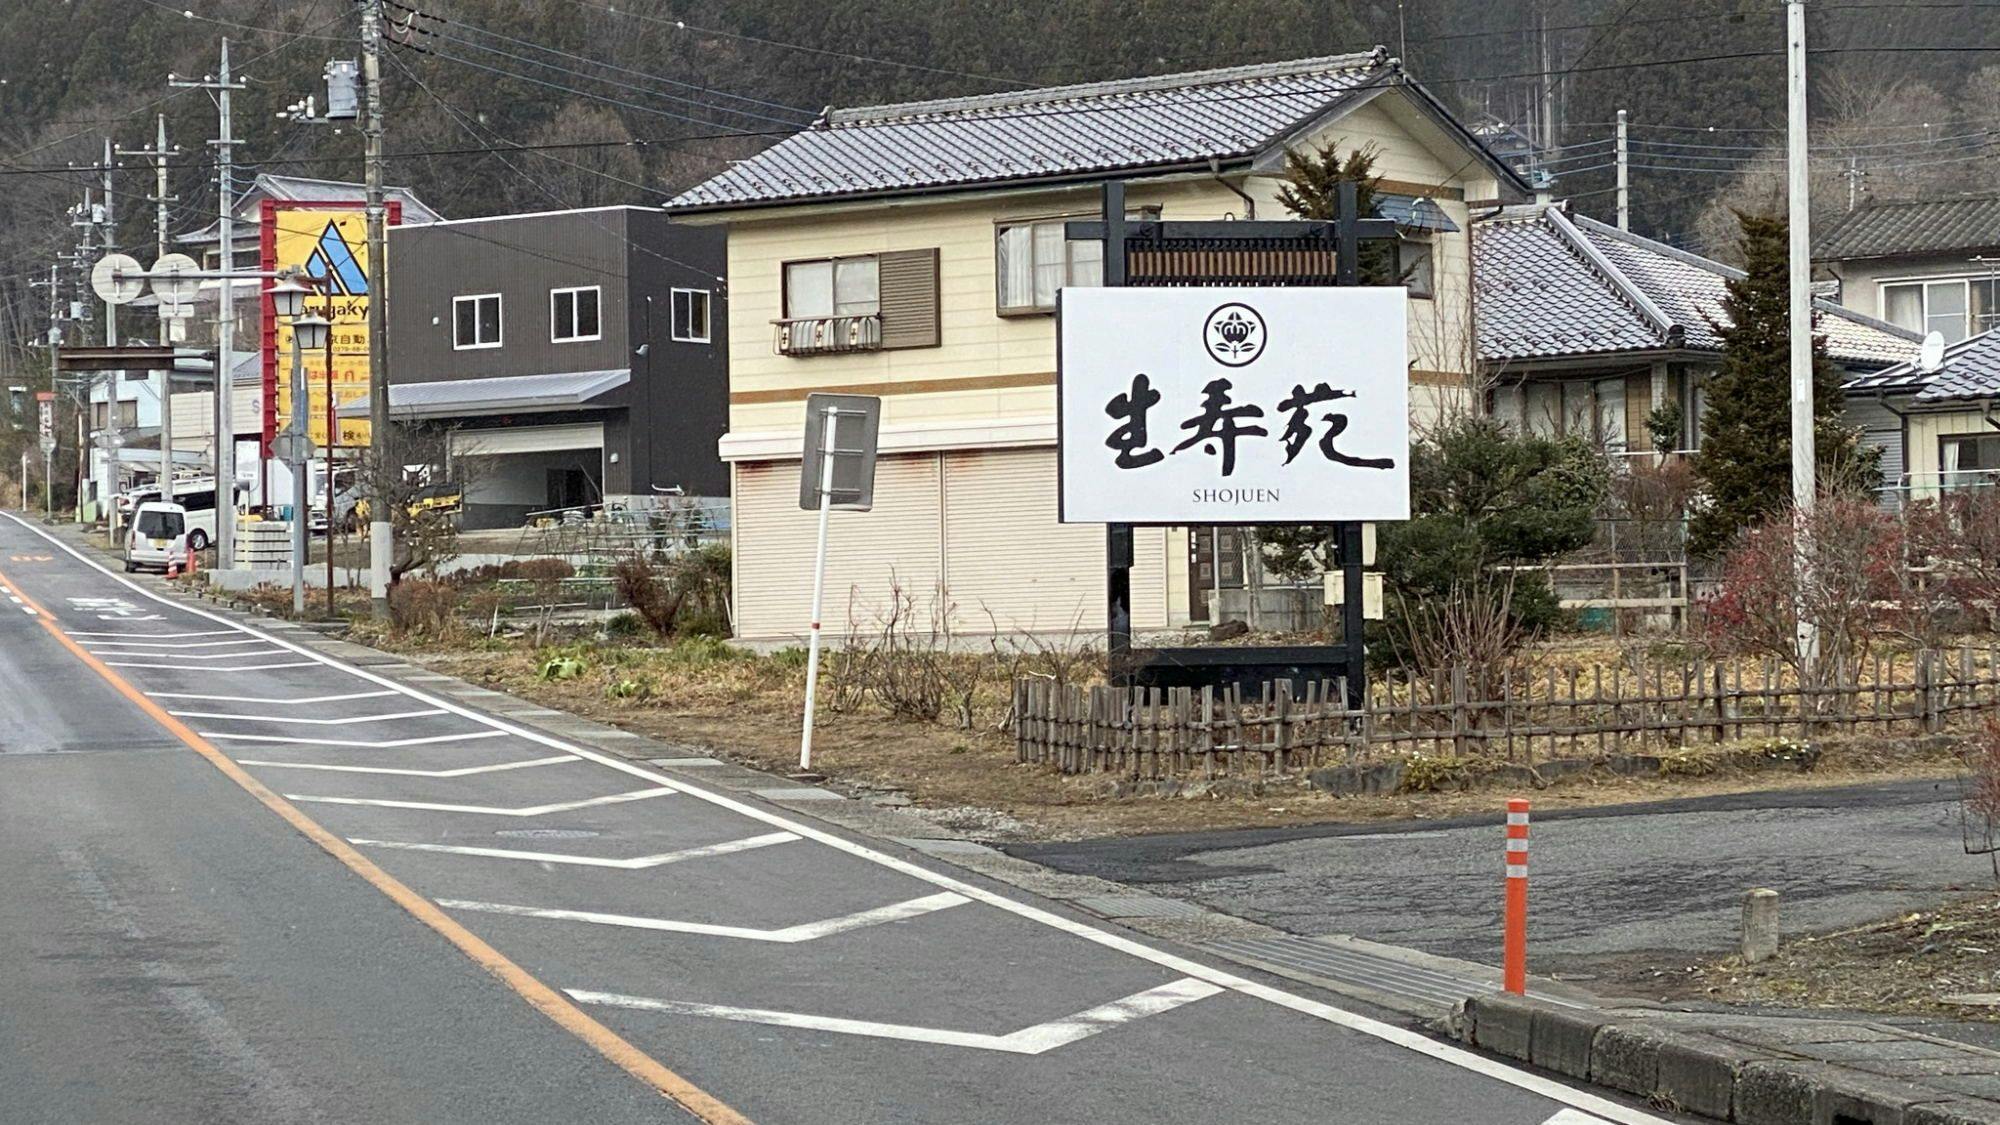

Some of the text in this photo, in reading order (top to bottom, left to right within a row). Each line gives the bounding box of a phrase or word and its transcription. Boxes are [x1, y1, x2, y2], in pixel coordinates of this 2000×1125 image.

[1105, 373, 1395, 477] 生寿苑
[1192, 488, 1280, 505] SHOJUEN
